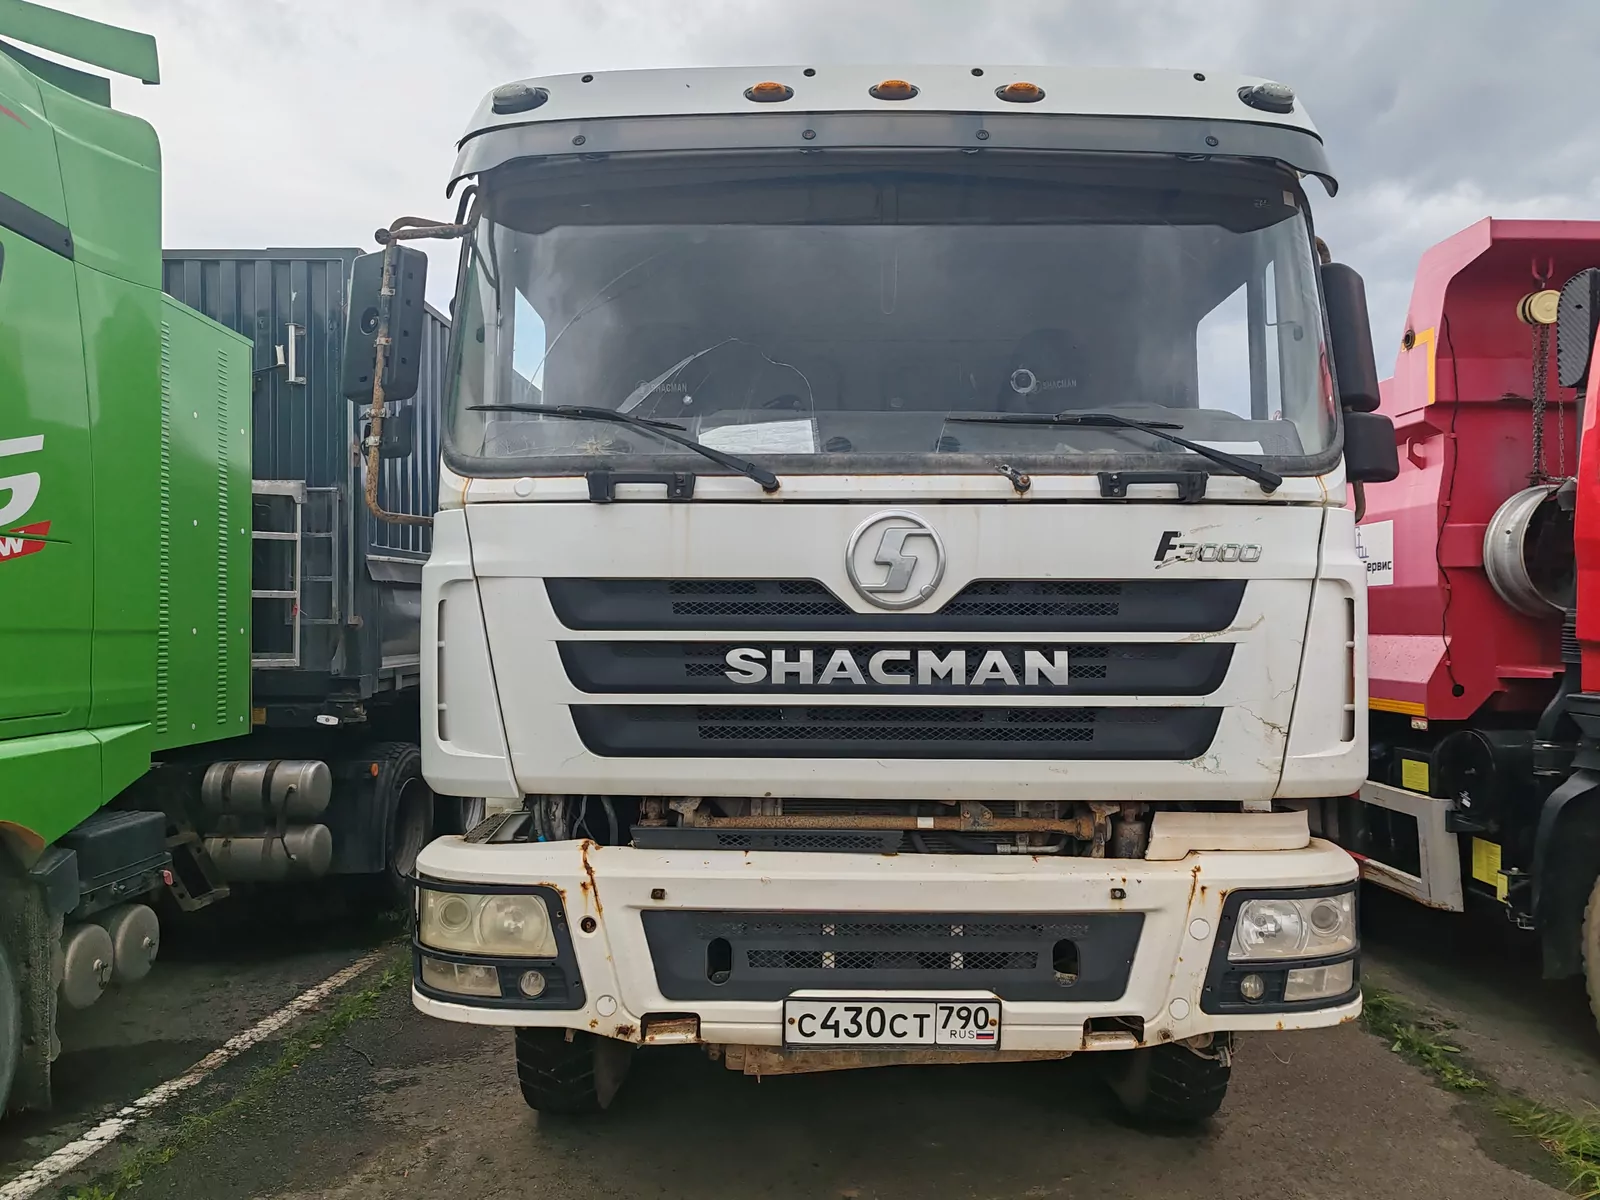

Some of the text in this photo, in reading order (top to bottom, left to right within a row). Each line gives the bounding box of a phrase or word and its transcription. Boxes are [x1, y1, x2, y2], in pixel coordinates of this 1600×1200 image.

[1153, 531, 1263, 563] F3000
[1363, 561, 1392, 574] ервис
[724, 647, 1069, 686] SHACMAN
[938, 1005, 990, 1030] 790
[949, 1029, 976, 1040] RUS
